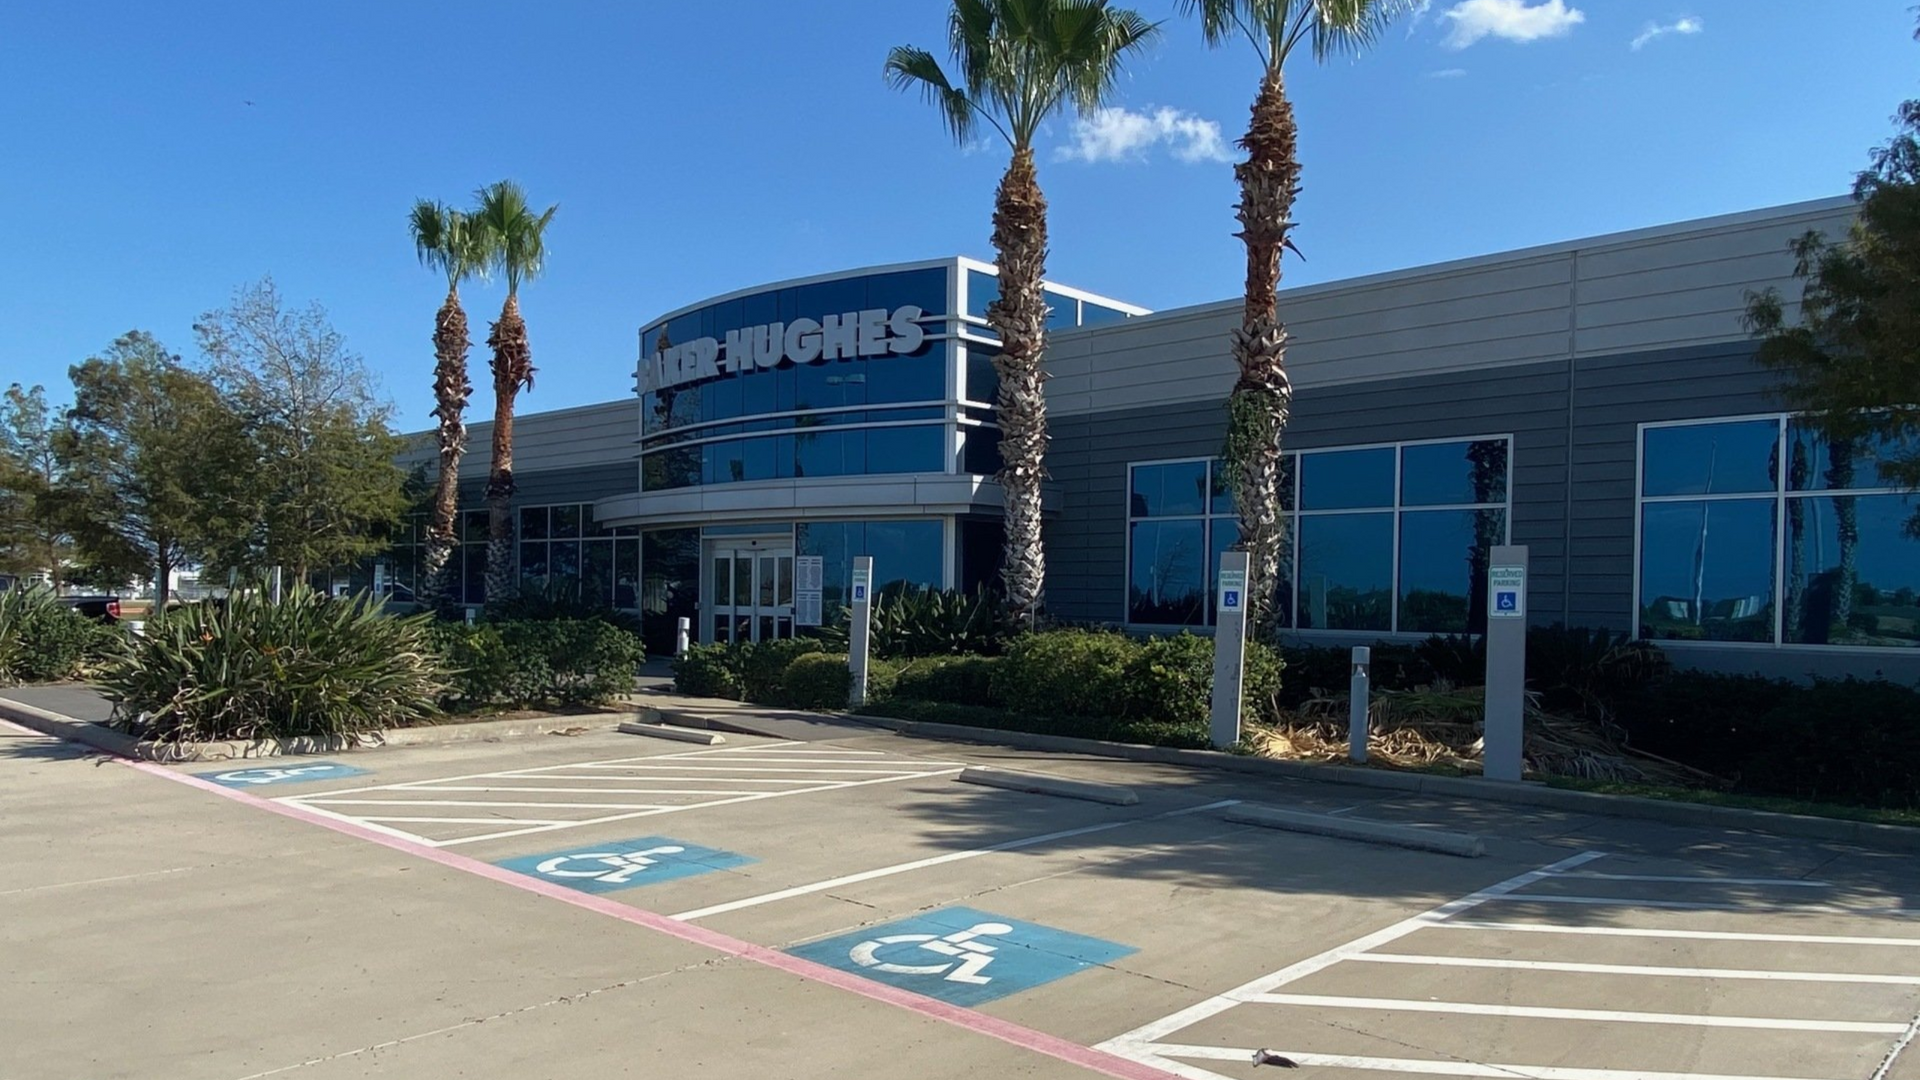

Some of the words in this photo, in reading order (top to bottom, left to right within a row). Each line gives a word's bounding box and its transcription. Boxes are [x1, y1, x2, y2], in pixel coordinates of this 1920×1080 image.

[637, 337, 720, 395] BAKER
[725, 305, 924, 373] HUGHES
[1491, 570, 1523, 579] RESERVED
